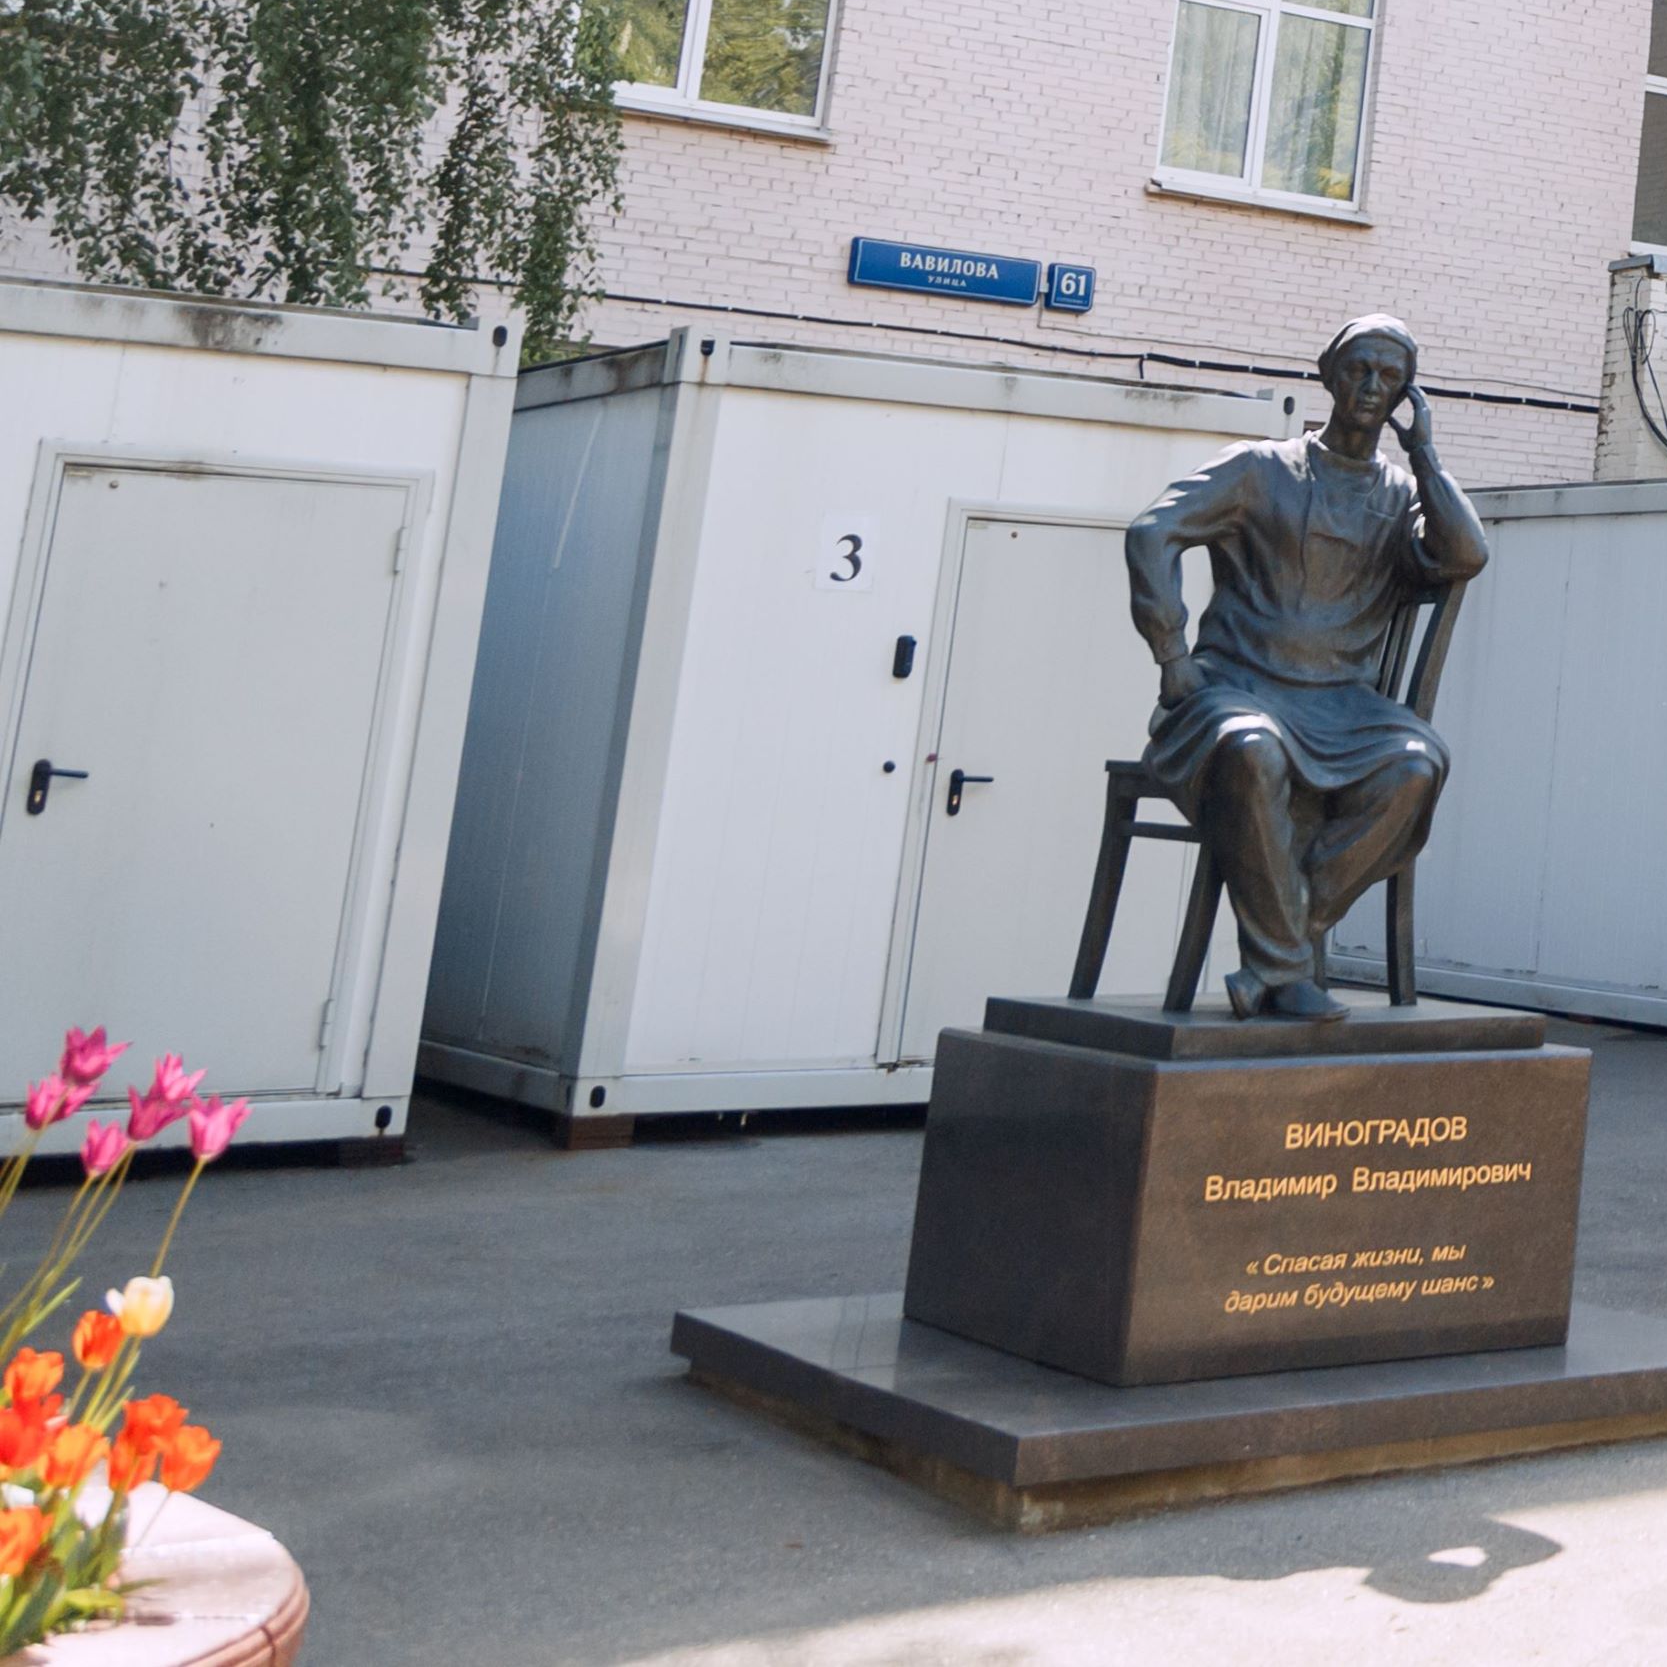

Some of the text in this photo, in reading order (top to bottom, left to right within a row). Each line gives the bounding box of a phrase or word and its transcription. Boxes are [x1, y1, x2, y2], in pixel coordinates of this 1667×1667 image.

[900, 251, 999, 280] ВАВИЛОВА
[927, 275, 967, 287] УЛИЦА
[1060, 271, 1087, 297] 61
[829, 533, 863, 582] 3
[1284, 1116, 1468, 1150] ВИНОГРАДОВ
[1204, 1163, 1532, 1202] Владимир Владимирович
[1352, 1246, 1424, 1270] жизни,
[1431, 1243, 1466, 1262] мы
[1223, 1289, 1297, 1313] дарим
[1303, 1281, 1416, 1309] будущему
